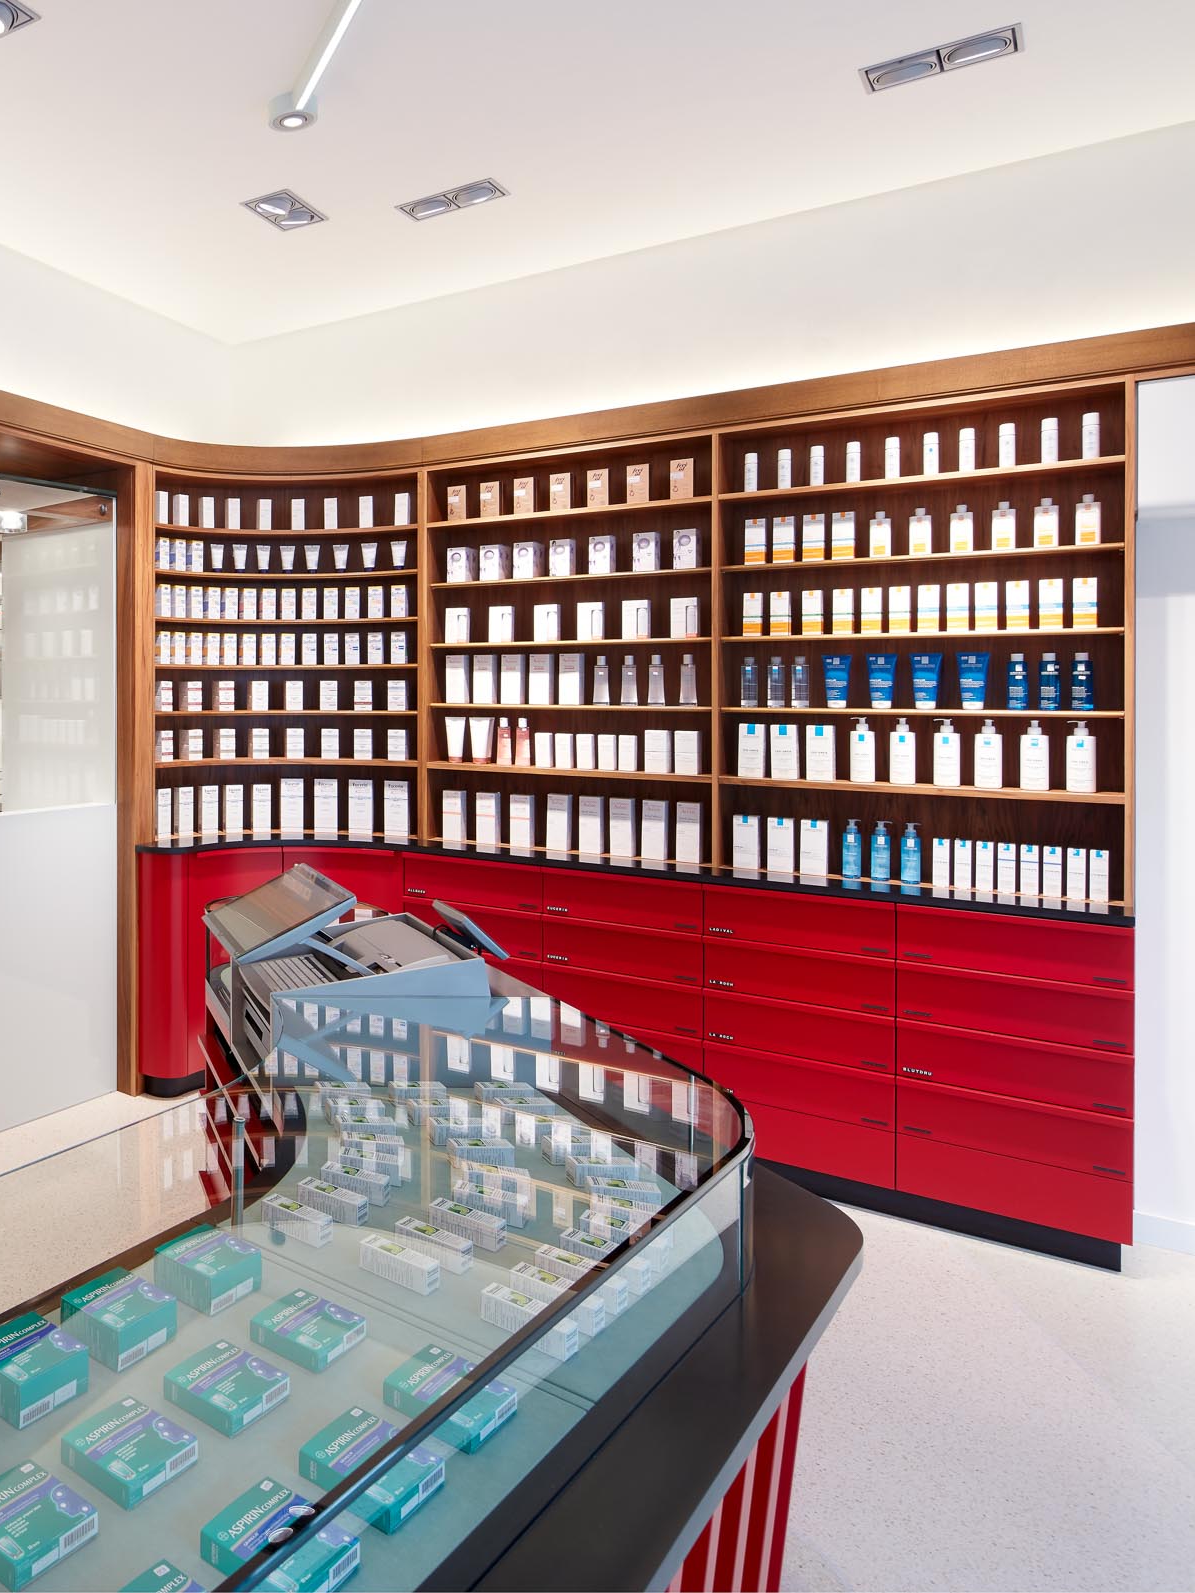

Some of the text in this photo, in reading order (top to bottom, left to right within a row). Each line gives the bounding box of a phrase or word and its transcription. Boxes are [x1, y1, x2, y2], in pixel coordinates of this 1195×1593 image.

[82, 1284, 110, 1303] ASPIRIN
[19, 1320, 46, 1335] COMPLEX
[186, 1358, 215, 1381] ASPIRIN
[407, 1363, 433, 1387] ASPIRIN
[85, 1405, 147, 1445] ASPIRIN COMPLEX
[324, 1415, 378, 1457] ASPIRIN COMPLEX
[14, 1471, 47, 1492] COMPLEX
[227, 1488, 290, 1539] ASPIRIN COMPLEX
[156, 1574, 187, 1593] OMPLEX
